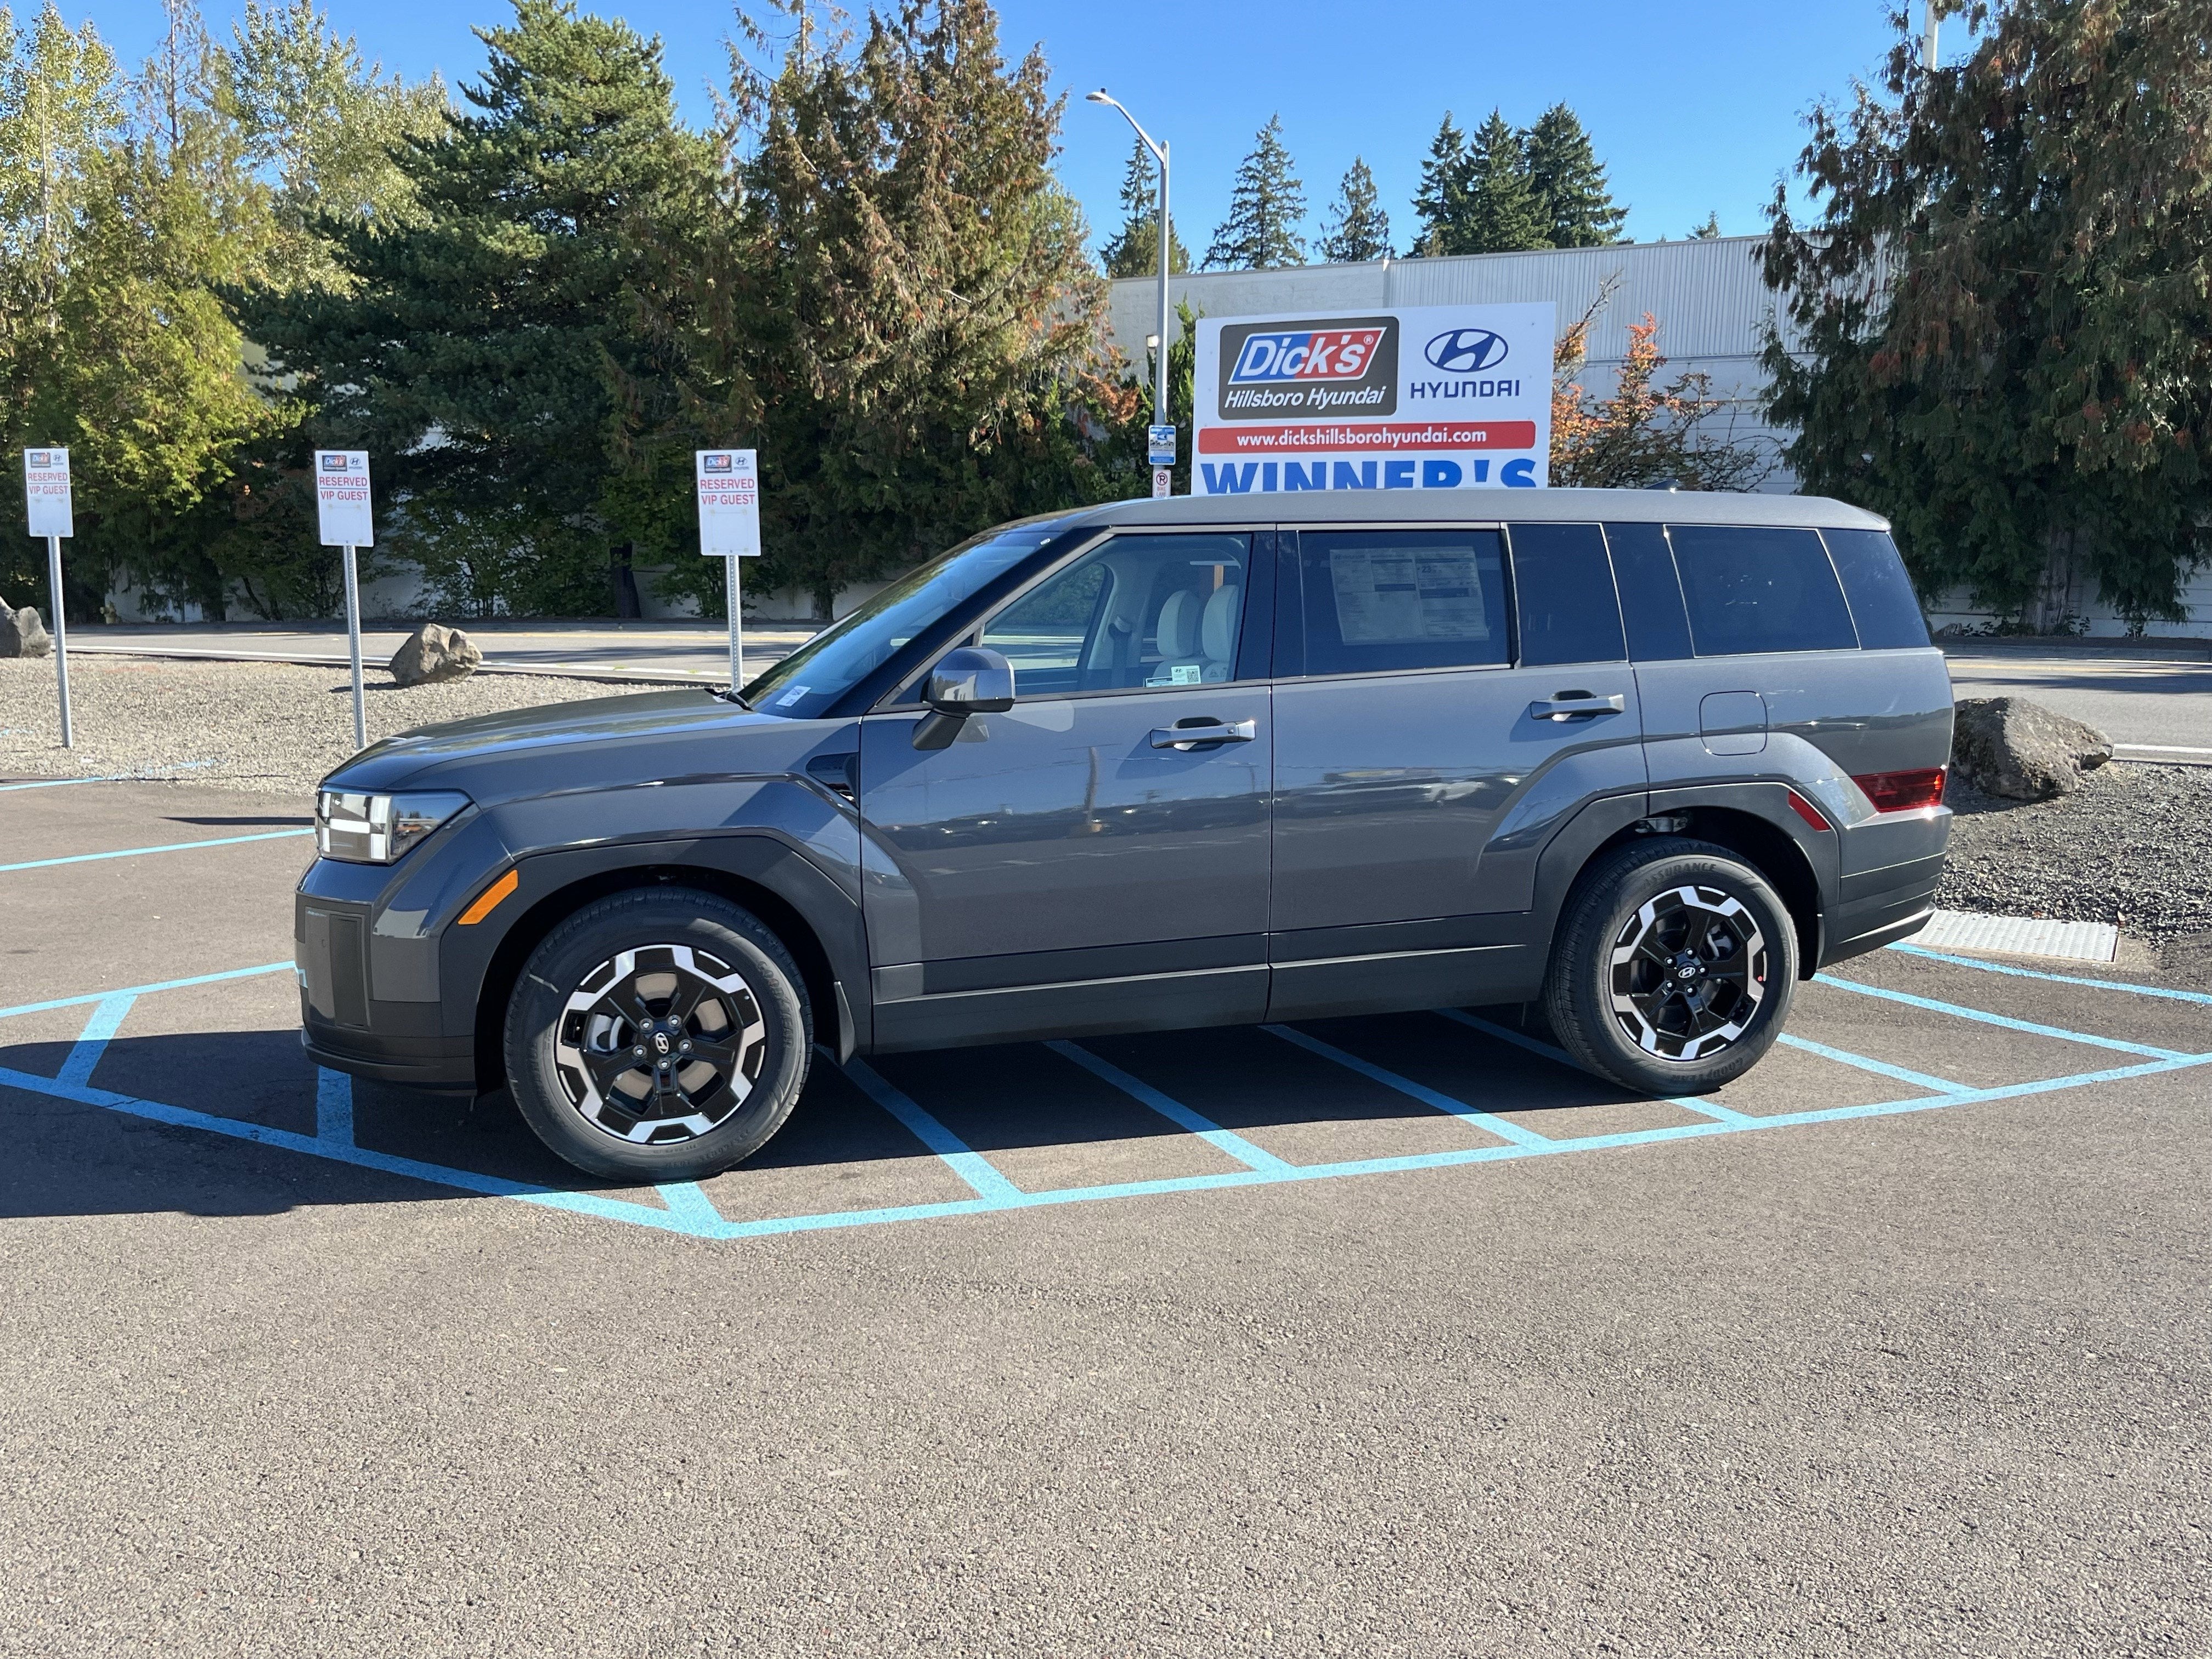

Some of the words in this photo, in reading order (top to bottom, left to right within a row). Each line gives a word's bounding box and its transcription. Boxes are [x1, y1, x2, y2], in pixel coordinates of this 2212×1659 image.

[1240, 335, 1365, 376] Dick's
[1410, 380, 1520, 399] HYUNDAI
[1224, 390, 1304, 408] Hillsboro
[1306, 386, 1386, 410] Hyundai
[1237, 427, 1486, 448] www.dickshillsborohyundai.com
[28, 472, 68, 481] RESERVED
[319, 477, 368, 487] RESERVED
[700, 478, 755, 489] RESERVED
[29, 486, 41, 494] VIP
[43, 486, 68, 494] GUEST
[320, 490, 335, 500] VIP
[337, 491, 368, 500] GUEST
[701, 495, 717, 505] VIP
[720, 494, 755, 505] GUEST
[1643, 862, 1717, 886] ASSURANCE
